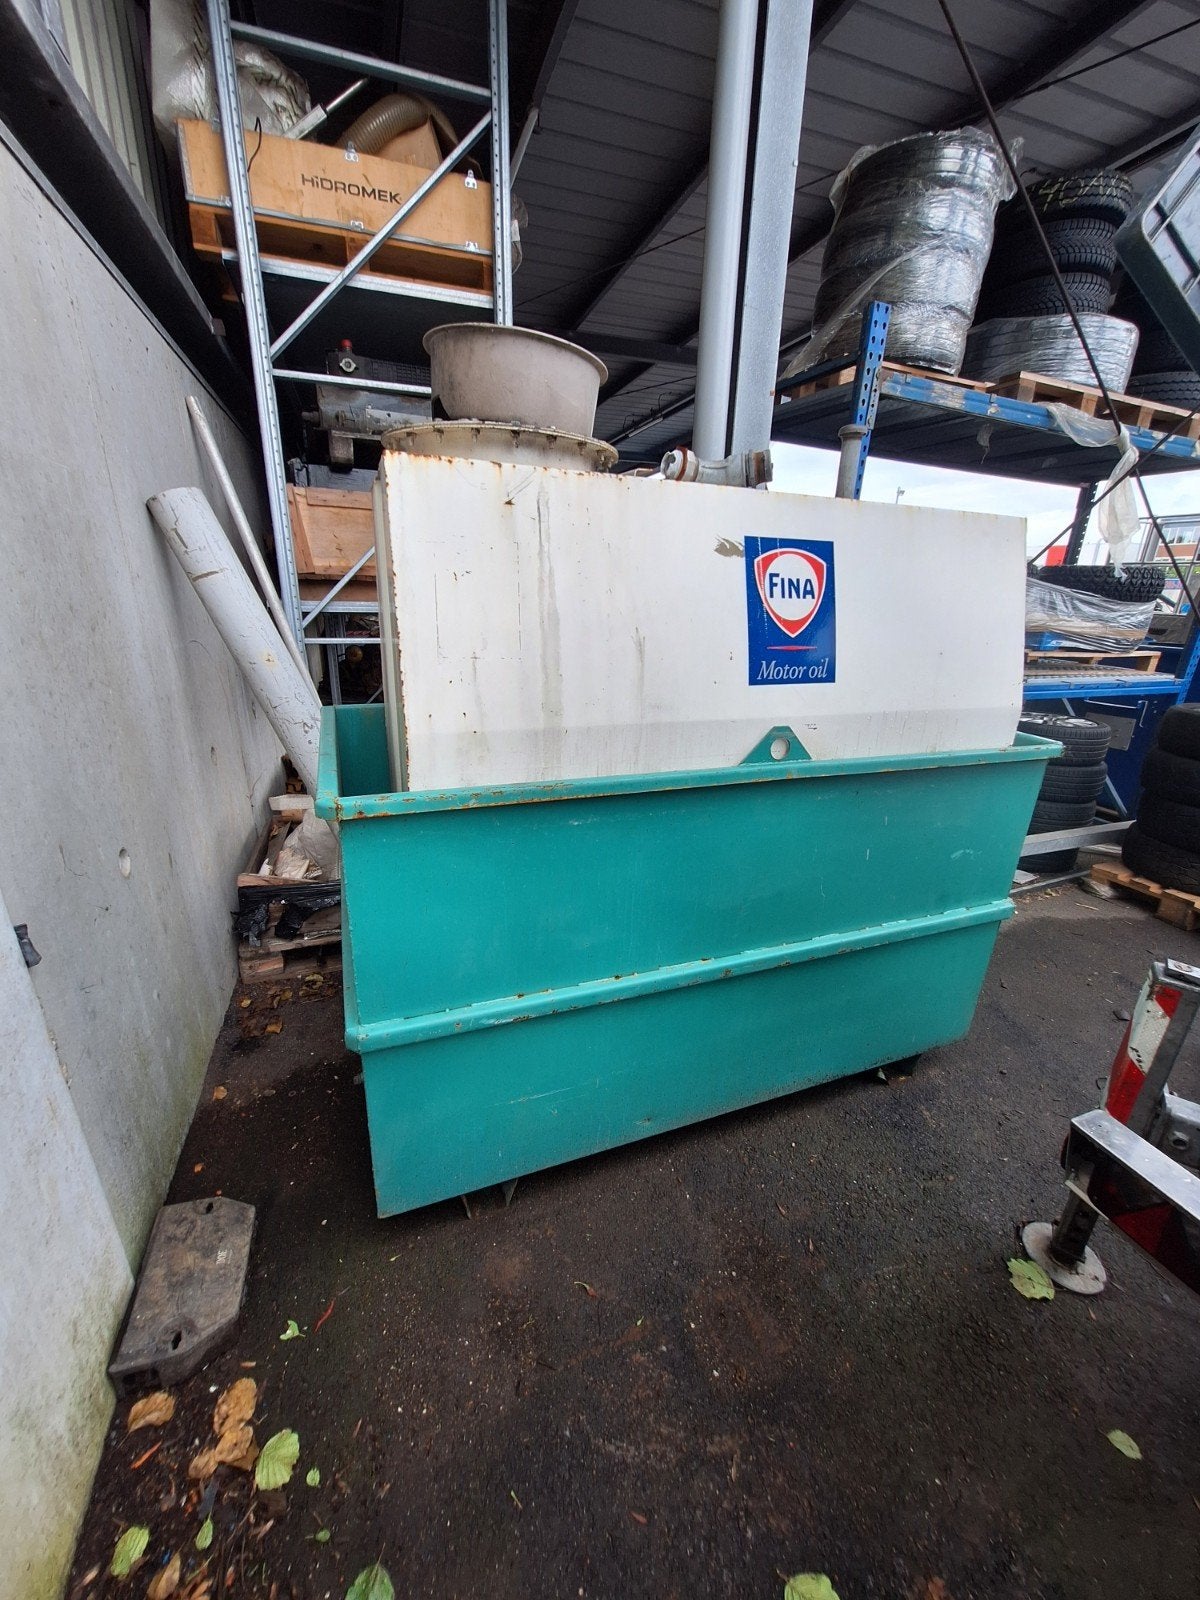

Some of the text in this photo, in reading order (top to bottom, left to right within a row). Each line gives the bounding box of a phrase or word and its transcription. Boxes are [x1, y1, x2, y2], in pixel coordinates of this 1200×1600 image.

[769, 572, 815, 599] FINA
[757, 658, 828, 680] Motor oil
